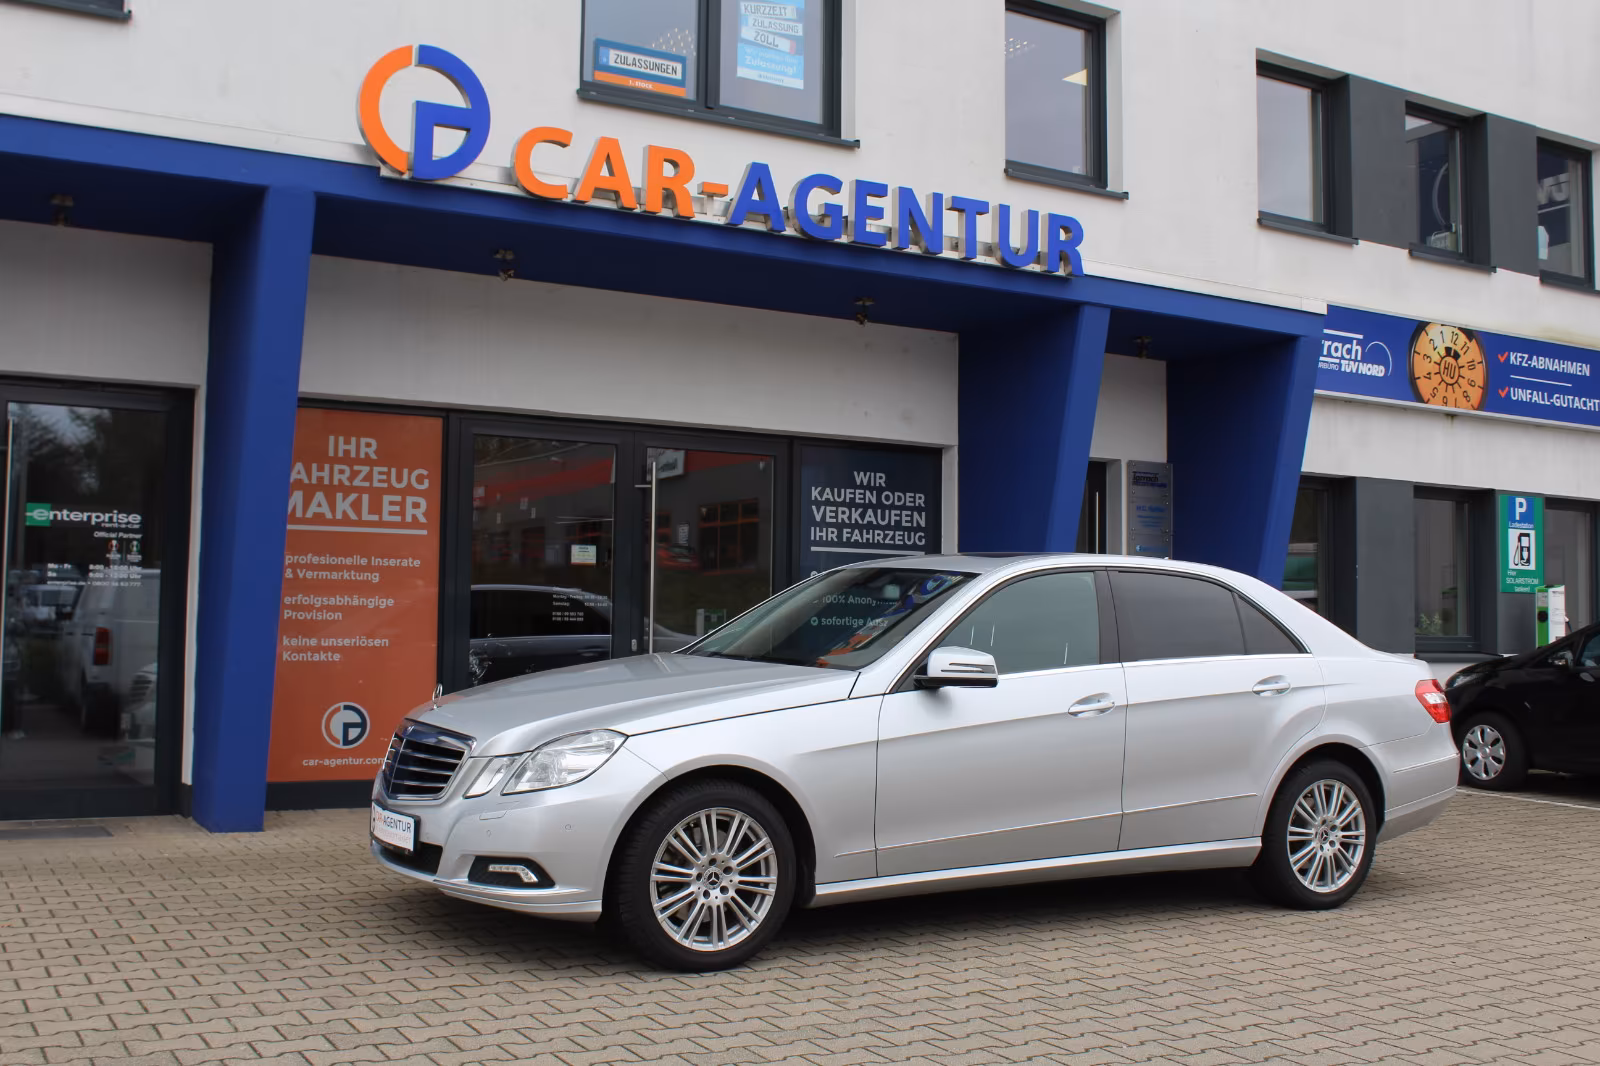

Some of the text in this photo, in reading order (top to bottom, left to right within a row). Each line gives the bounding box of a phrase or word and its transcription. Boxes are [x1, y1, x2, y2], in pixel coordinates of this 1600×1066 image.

[743, 4, 787, 17] KURZZEIT
[752, 18, 799, 34] ZULASSUNG
[754, 31, 779, 48] ZOLL
[613, 53, 678, 76] ZULASSUNGEN
[512, 126, 1085, 276] CAR-AGENTUR
[1450, 331, 1459, 346] 12
[1321, 339, 1362, 361] rach
[1340, 359, 1359, 374] TÜV
[1358, 362, 1386, 377] NORD
[1442, 360, 1457, 379] HU
[1509, 351, 1591, 377] KFZ-ABNAHMEN
[328, 435, 378, 459] IHR
[853, 471, 886, 487] WIR
[811, 486, 925, 507] KAUFEN ODER
[30, 508, 142, 526] enterprise
[811, 505, 926, 528] VERKAUFEN
[1515, 497, 1527, 520] P
[810, 527, 926, 545] IHR FAHRZEUG
[371, 556, 421, 567] Inserate
[285, 568, 380, 583] & Vermarktung
[283, 594, 395, 608] erfolgsabhängige
[283, 609, 342, 620] Provision
[821, 616, 864, 628] sofortige
[282, 635, 389, 647] keine unseriösen
[282, 651, 341, 661] Kontakte
